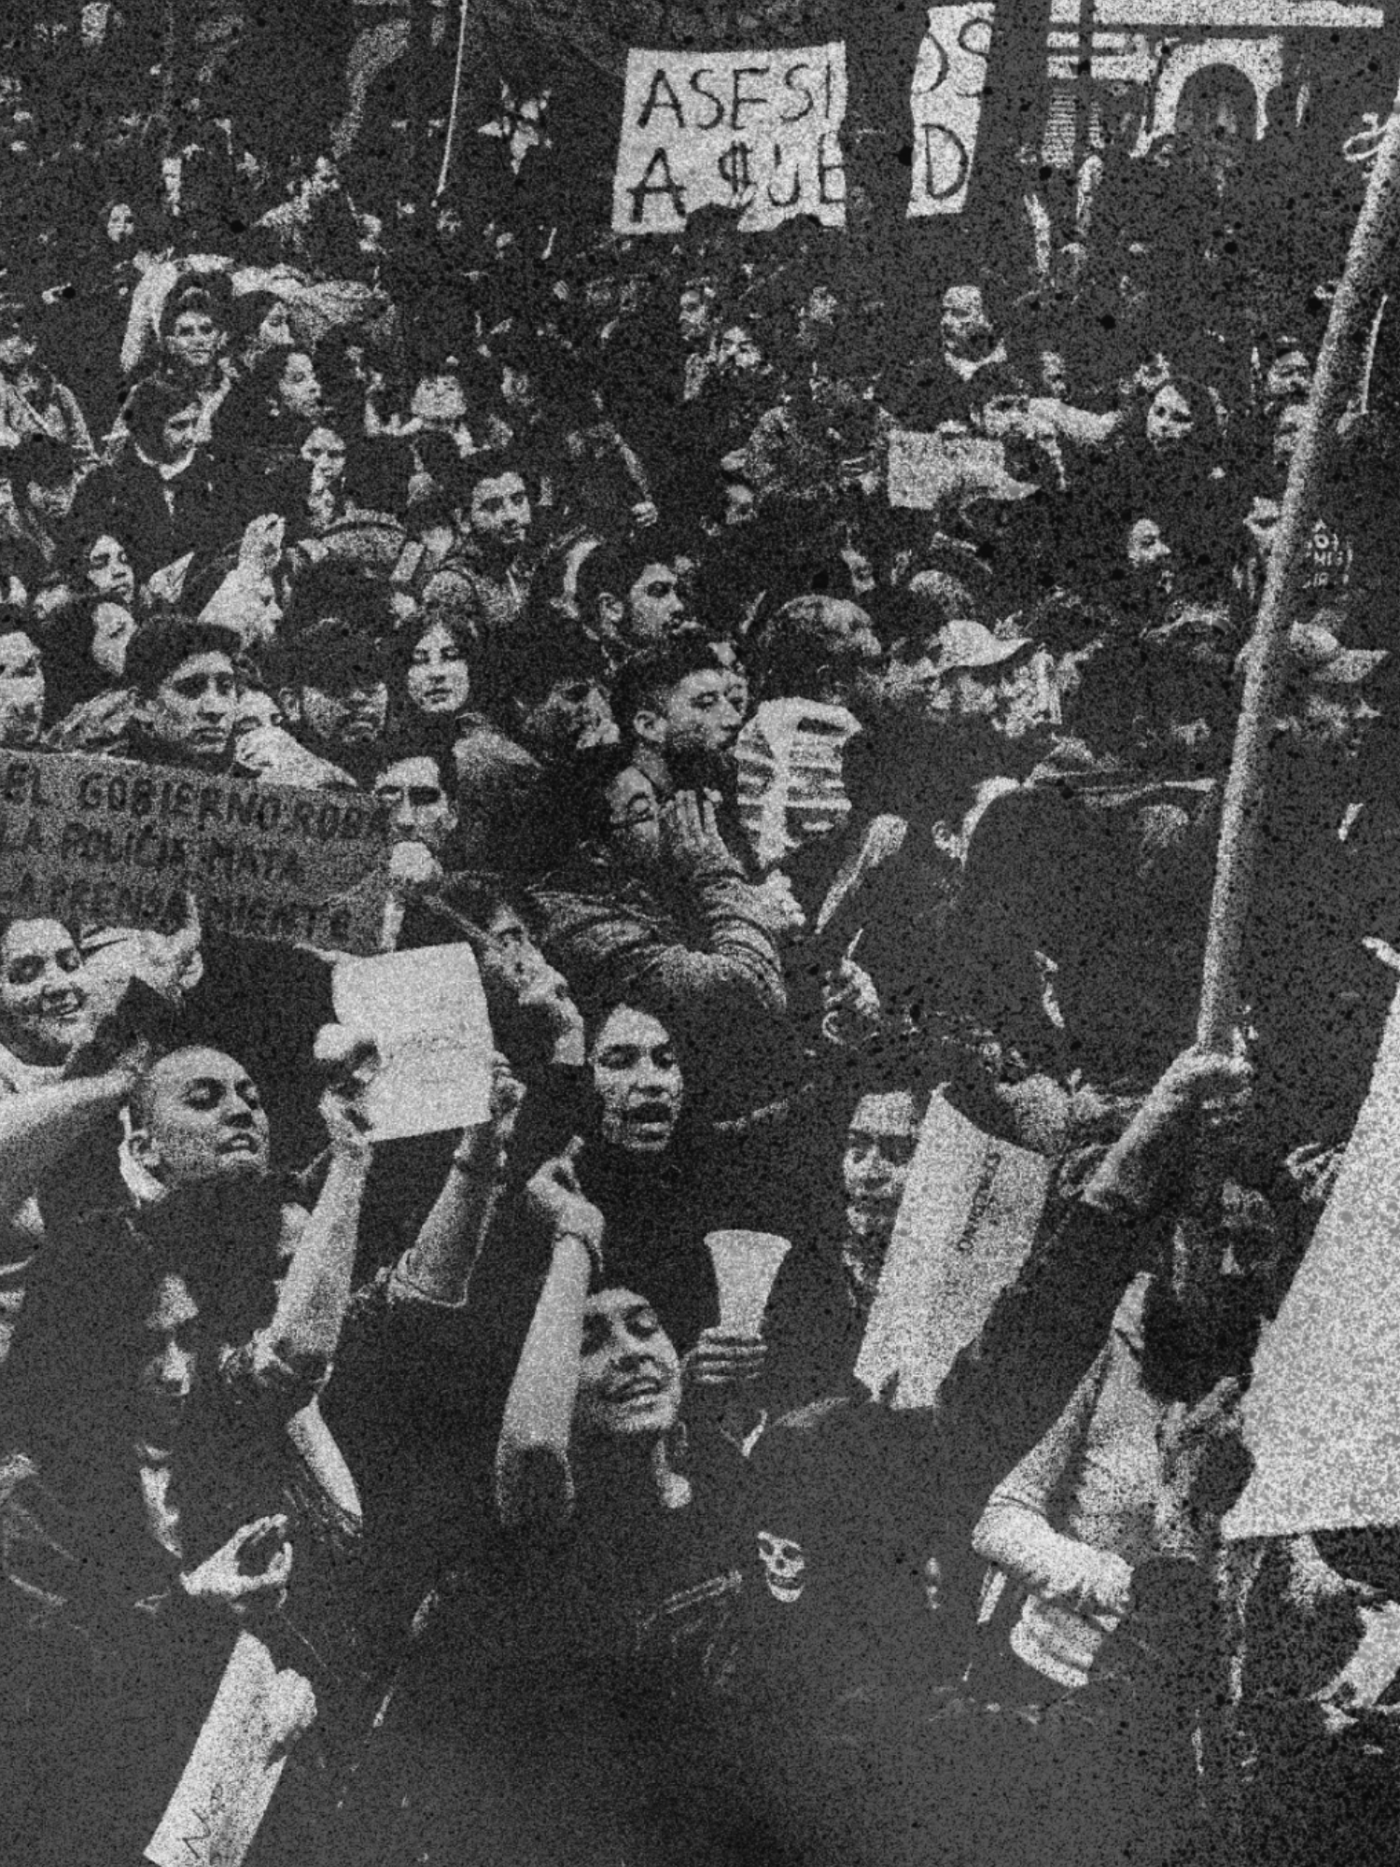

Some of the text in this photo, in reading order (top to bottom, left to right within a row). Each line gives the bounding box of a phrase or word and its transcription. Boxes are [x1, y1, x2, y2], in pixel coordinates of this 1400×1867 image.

[626, 147, 688, 223] A
[4, 763, 47, 806] EL
[77, 772, 282, 831] GOBIERNO
